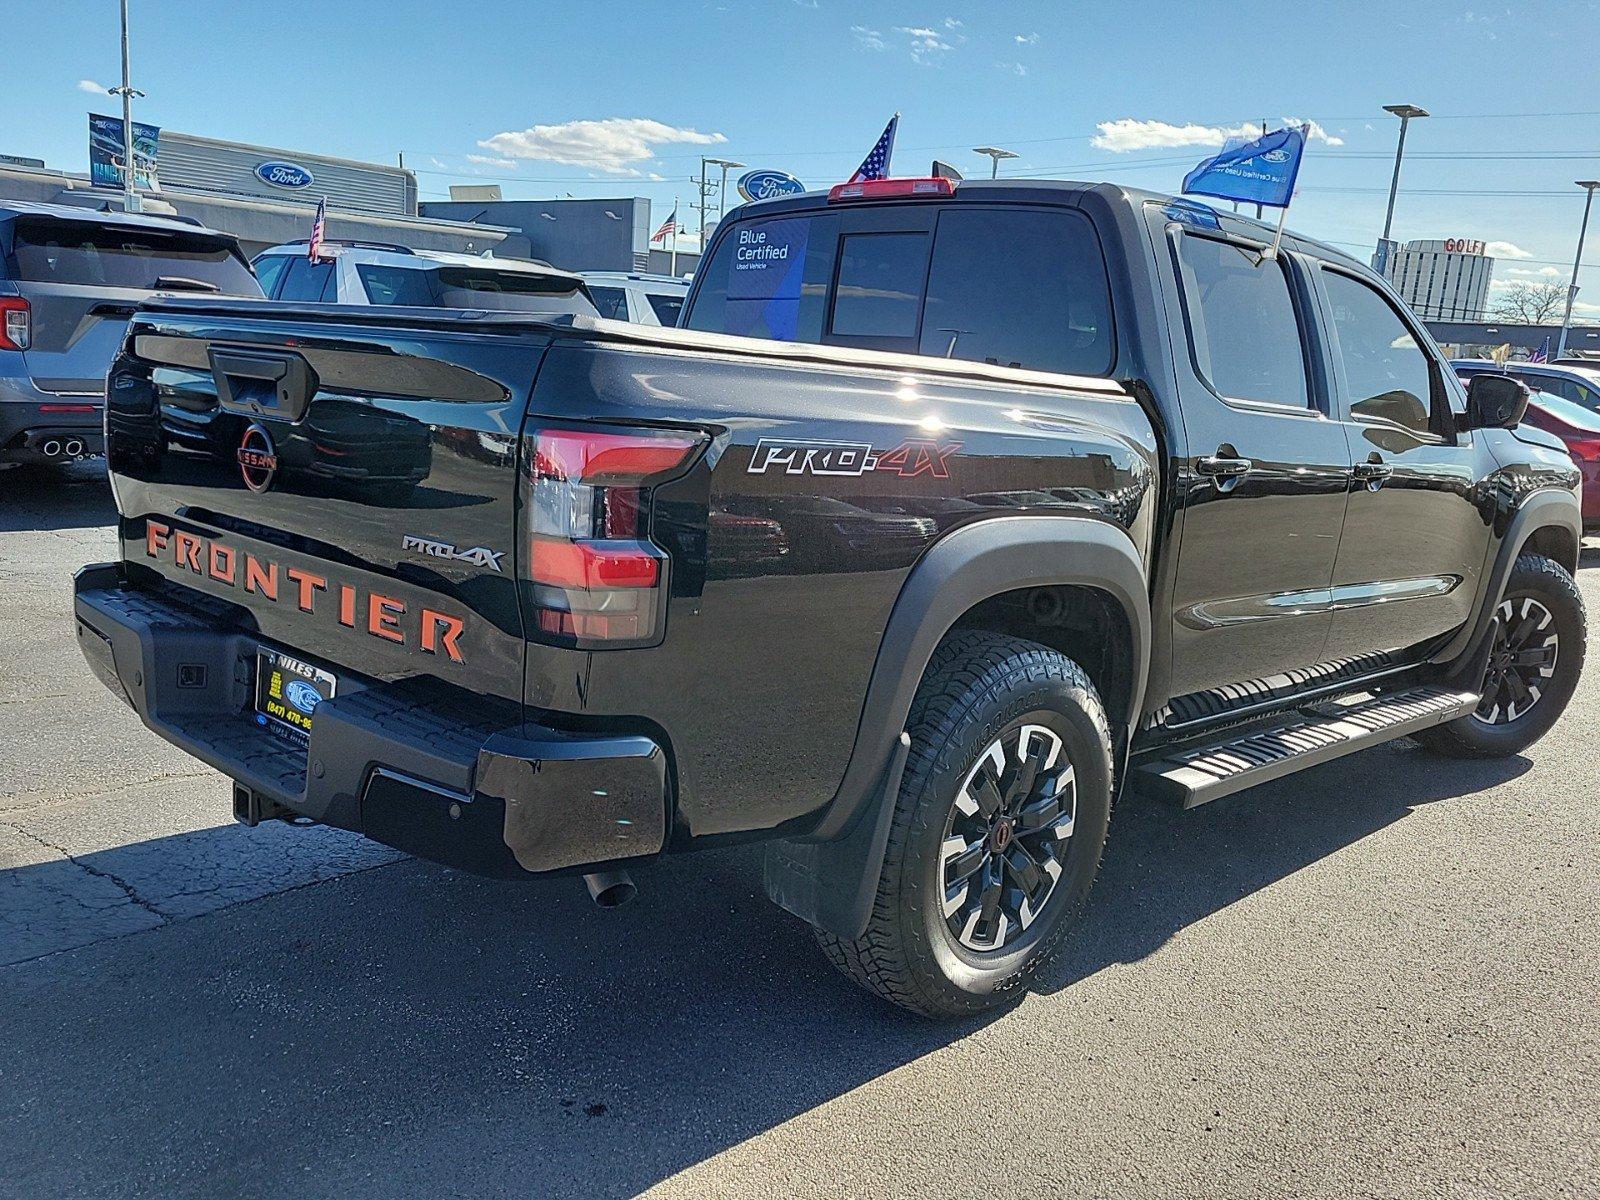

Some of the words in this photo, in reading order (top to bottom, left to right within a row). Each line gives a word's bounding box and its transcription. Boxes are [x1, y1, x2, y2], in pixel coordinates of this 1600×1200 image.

[270, 166, 302, 185] Ford
[758, 177, 796, 199] Ford
[739, 229, 766, 244] Blue
[737, 244, 789, 260] Certified
[145, 519, 466, 664] FRONTIER
[278, 655, 314, 678] NILES
[267, 701, 285, 718] (847)
